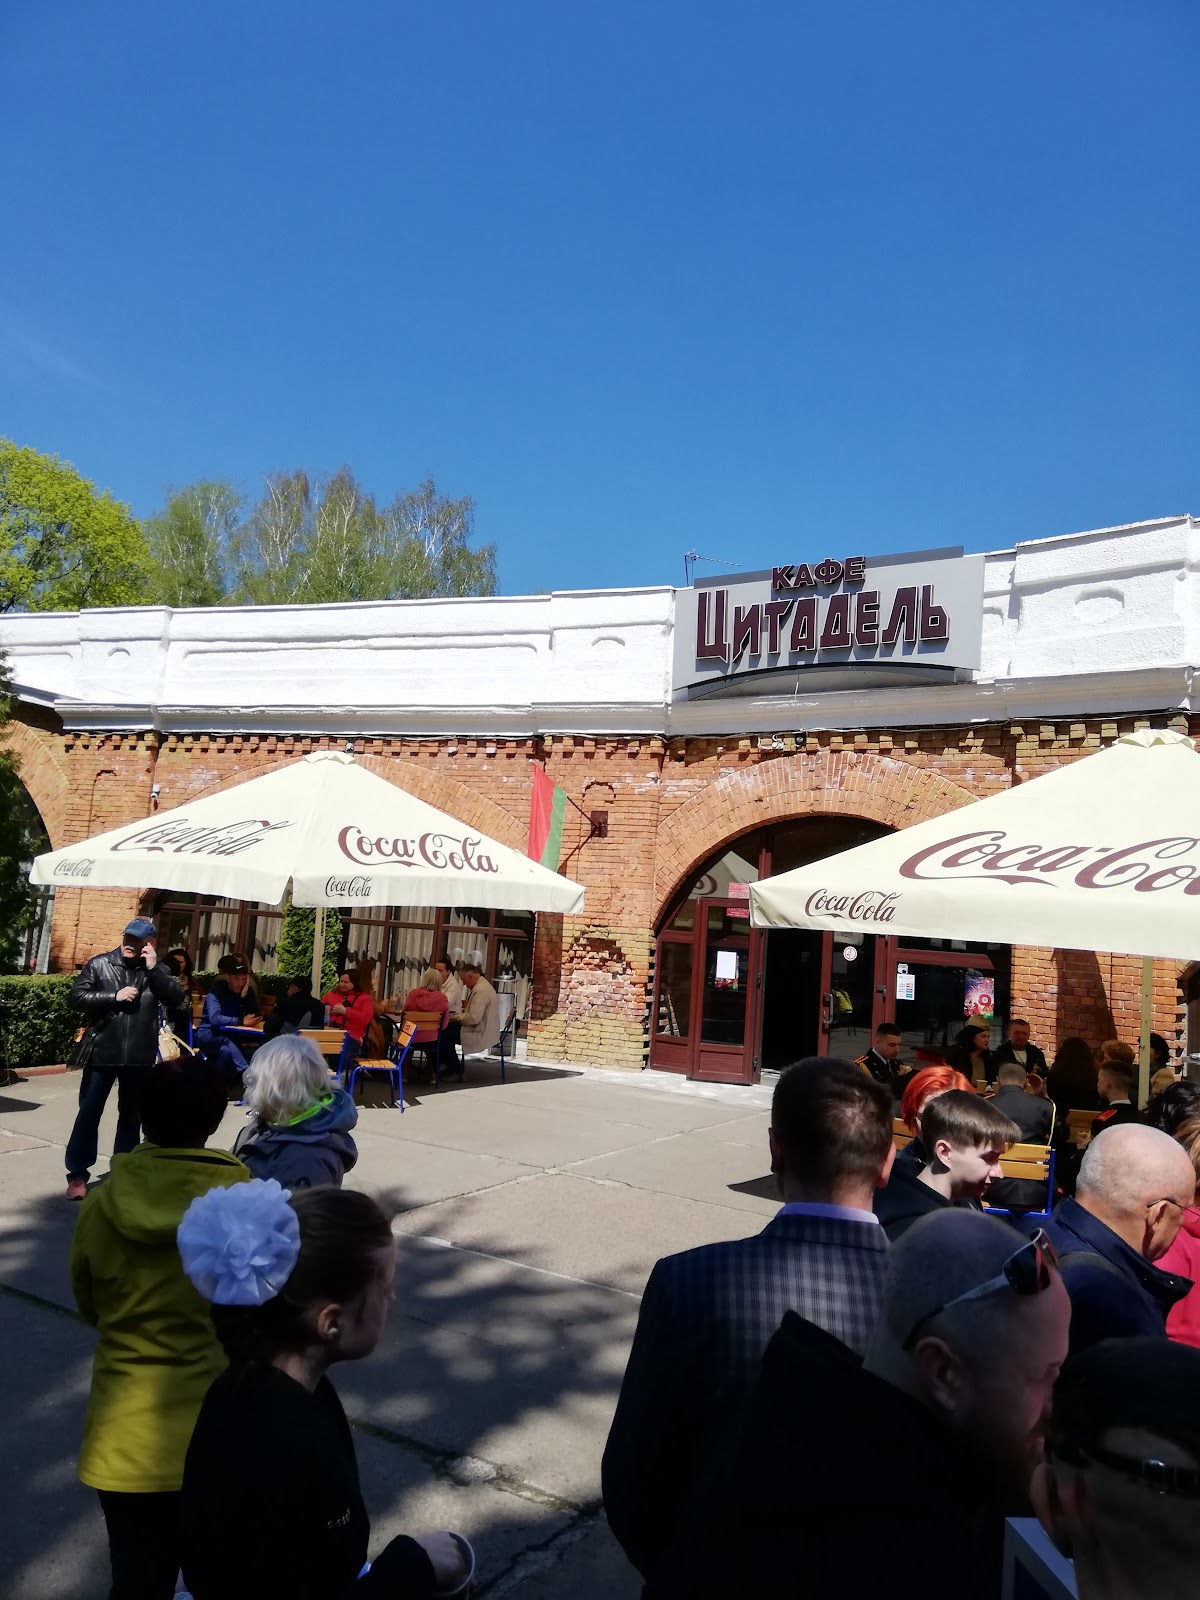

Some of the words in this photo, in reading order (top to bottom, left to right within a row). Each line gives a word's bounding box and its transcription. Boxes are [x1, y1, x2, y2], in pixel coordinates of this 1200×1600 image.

[771, 555, 866, 589] КАФЕ
[695, 583, 951, 664] ЦИТАДЕЛЬ
[338, 825, 499, 874] Coca-Cola
[899, 830, 1200, 896] Coca-Co
[805, 888, 903, 923] Coca-Cola
